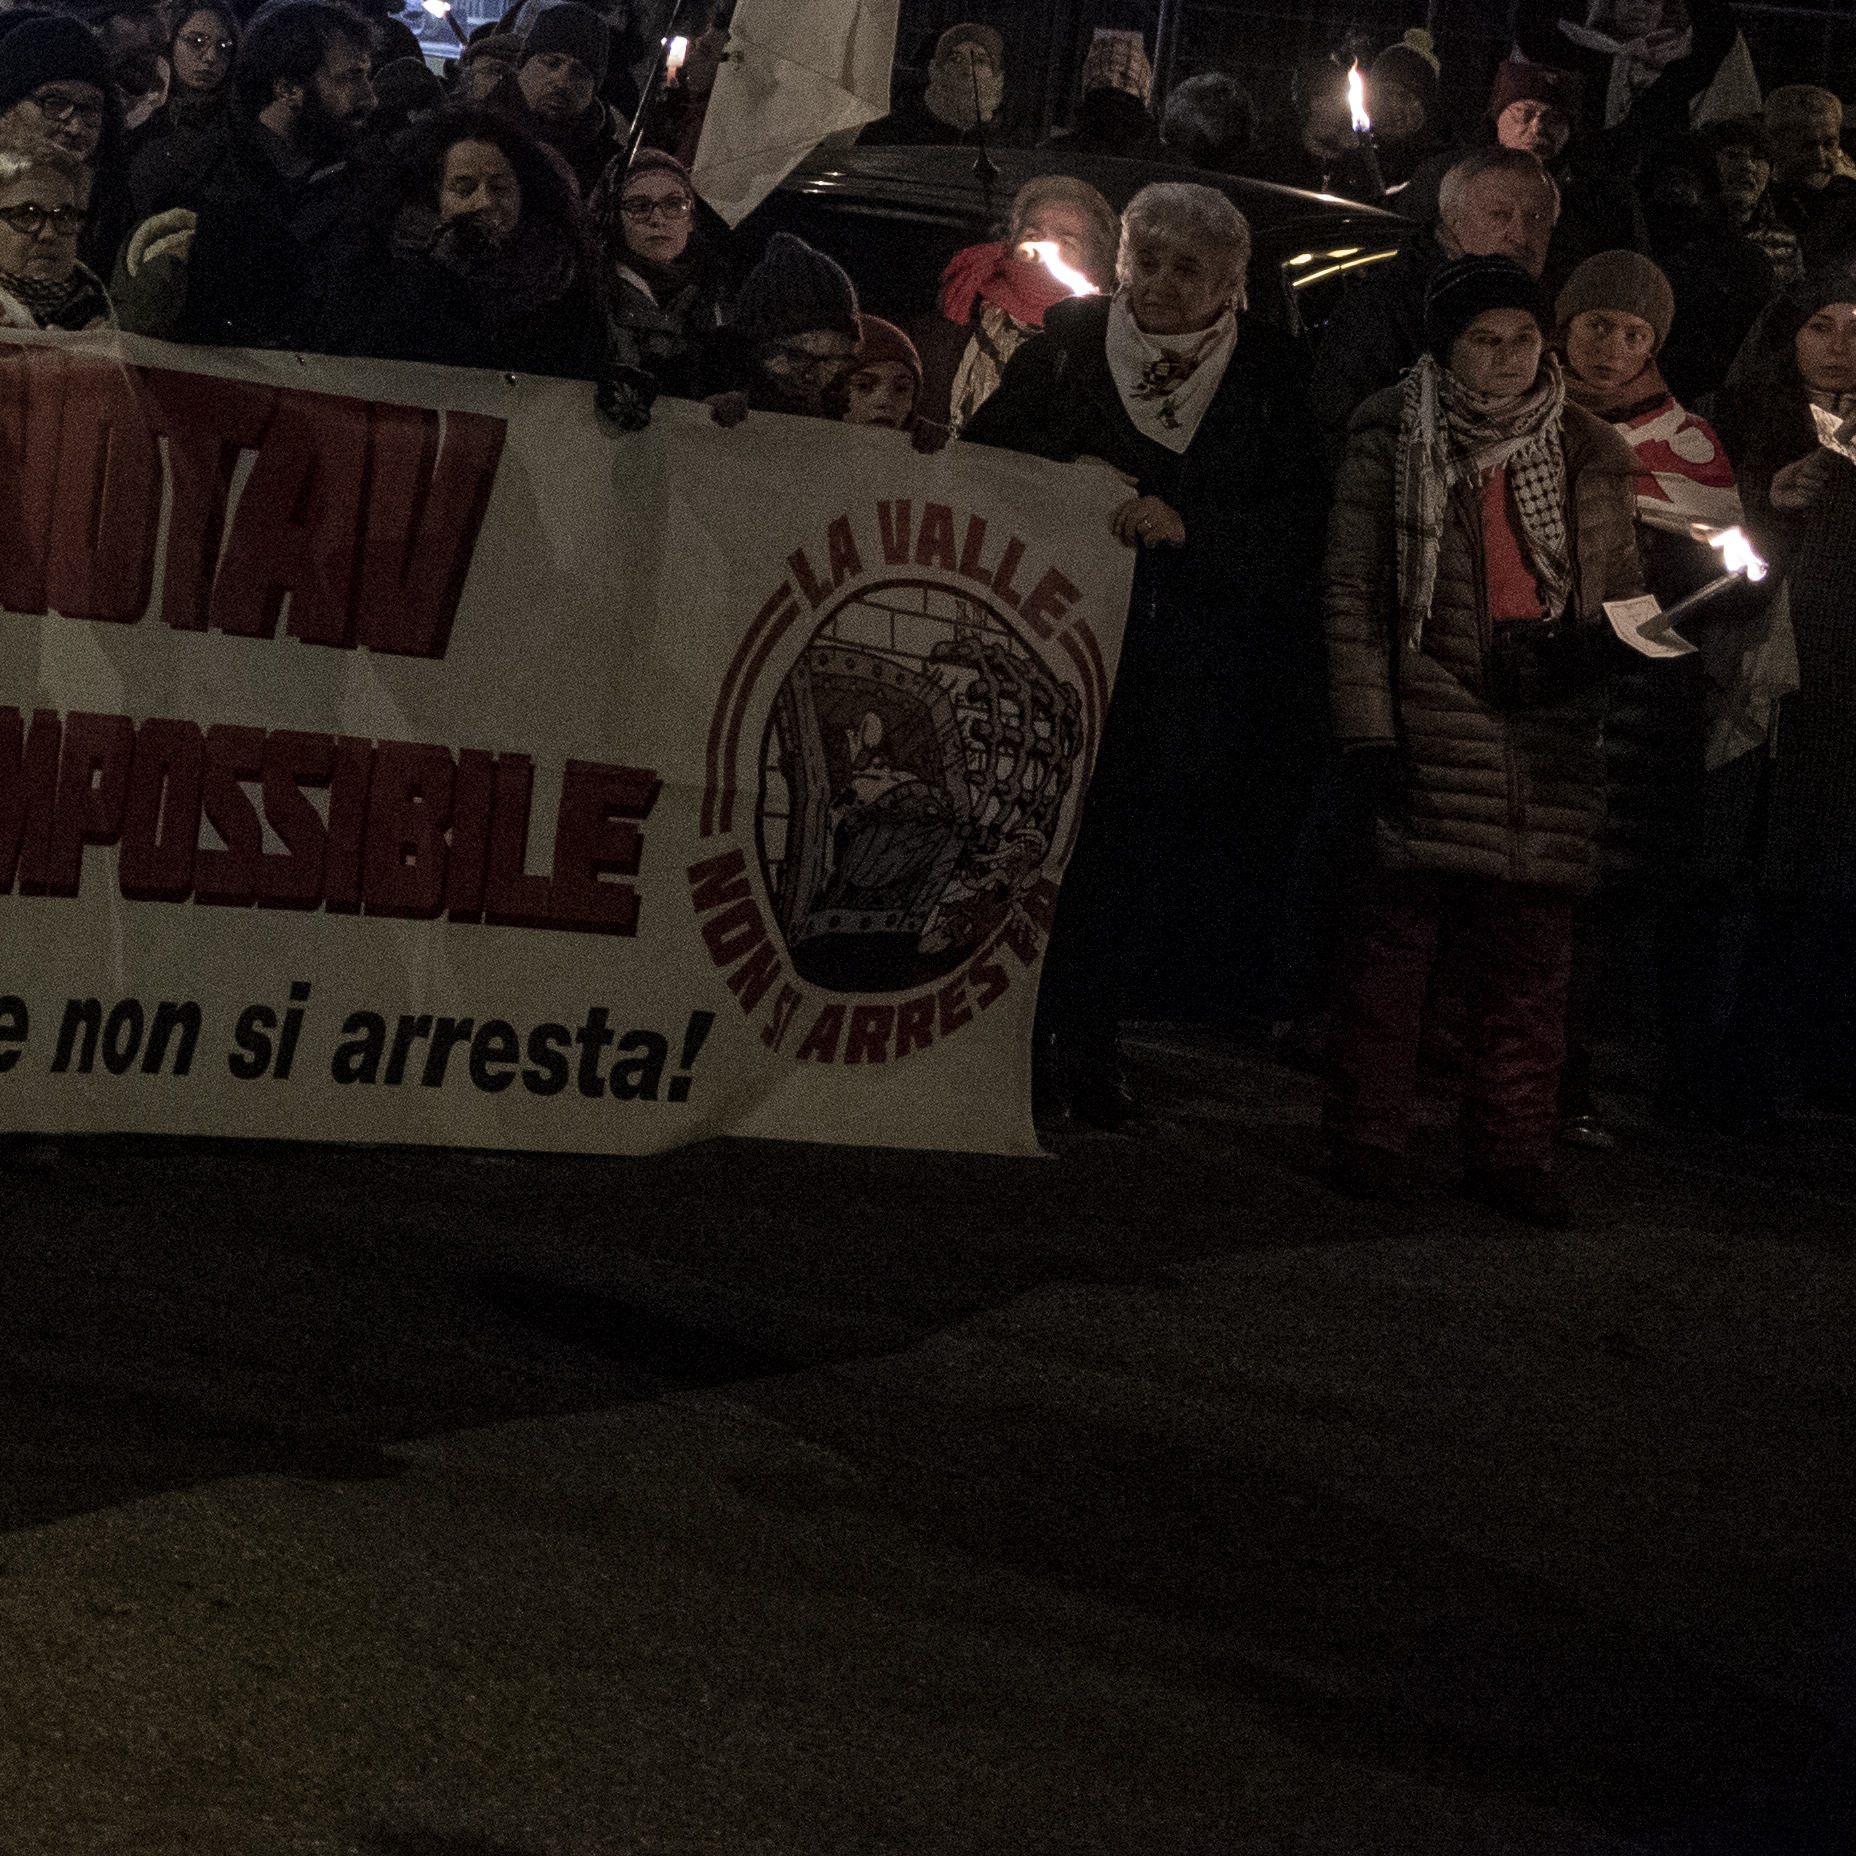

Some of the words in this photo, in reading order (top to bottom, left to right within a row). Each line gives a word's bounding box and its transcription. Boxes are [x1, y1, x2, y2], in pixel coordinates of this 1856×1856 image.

[787, 514, 864, 610] LA
[877, 498, 1084, 642] VALLE
[688, 848, 783, 1016] NON
[53, 984, 203, 1076] non
[228, 980, 310, 1080] si
[332, 1010, 715, 1103] arresta!
